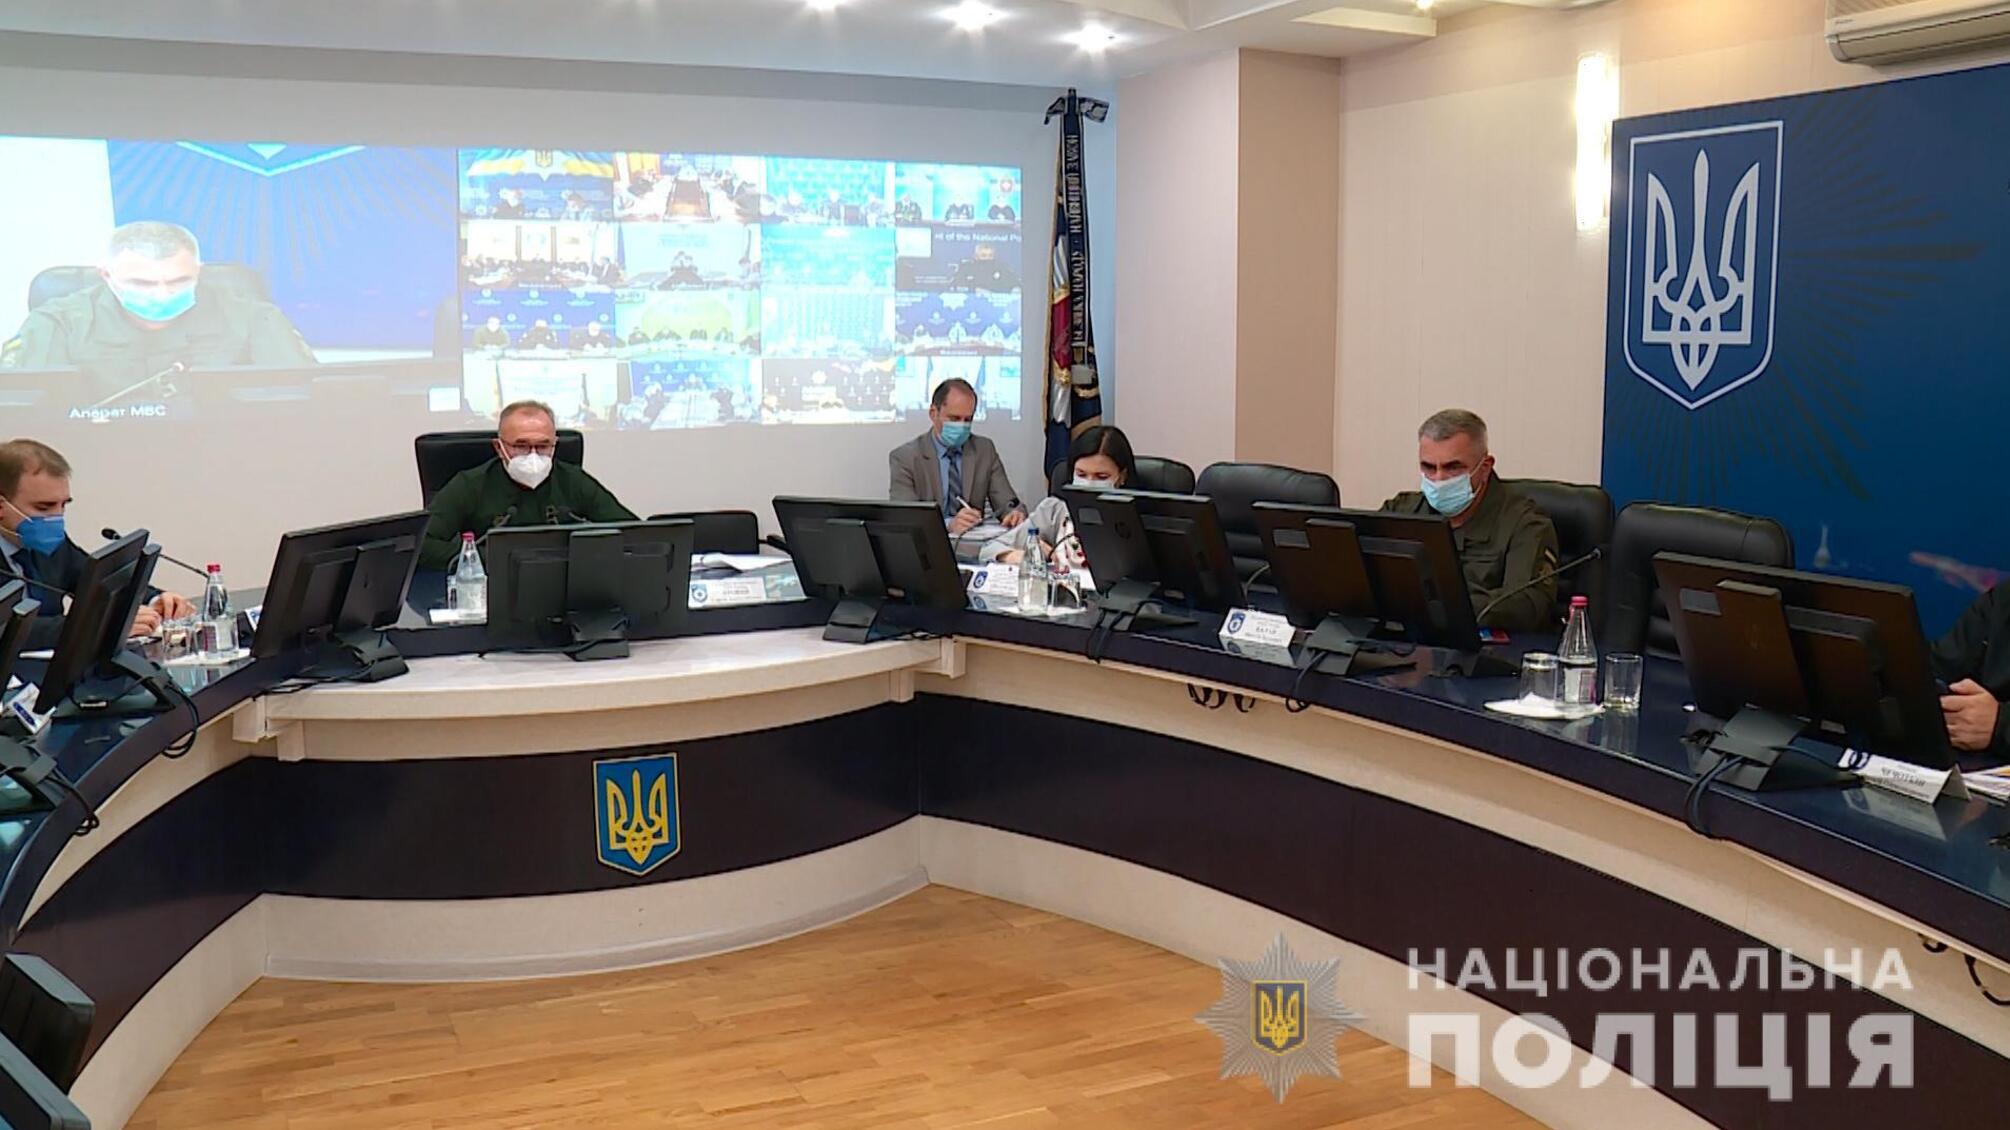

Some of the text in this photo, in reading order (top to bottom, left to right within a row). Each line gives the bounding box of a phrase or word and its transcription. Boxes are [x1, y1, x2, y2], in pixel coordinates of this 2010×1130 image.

[972, 233, 1008, 241] National
[69, 405, 166, 421] Апарат МВС
